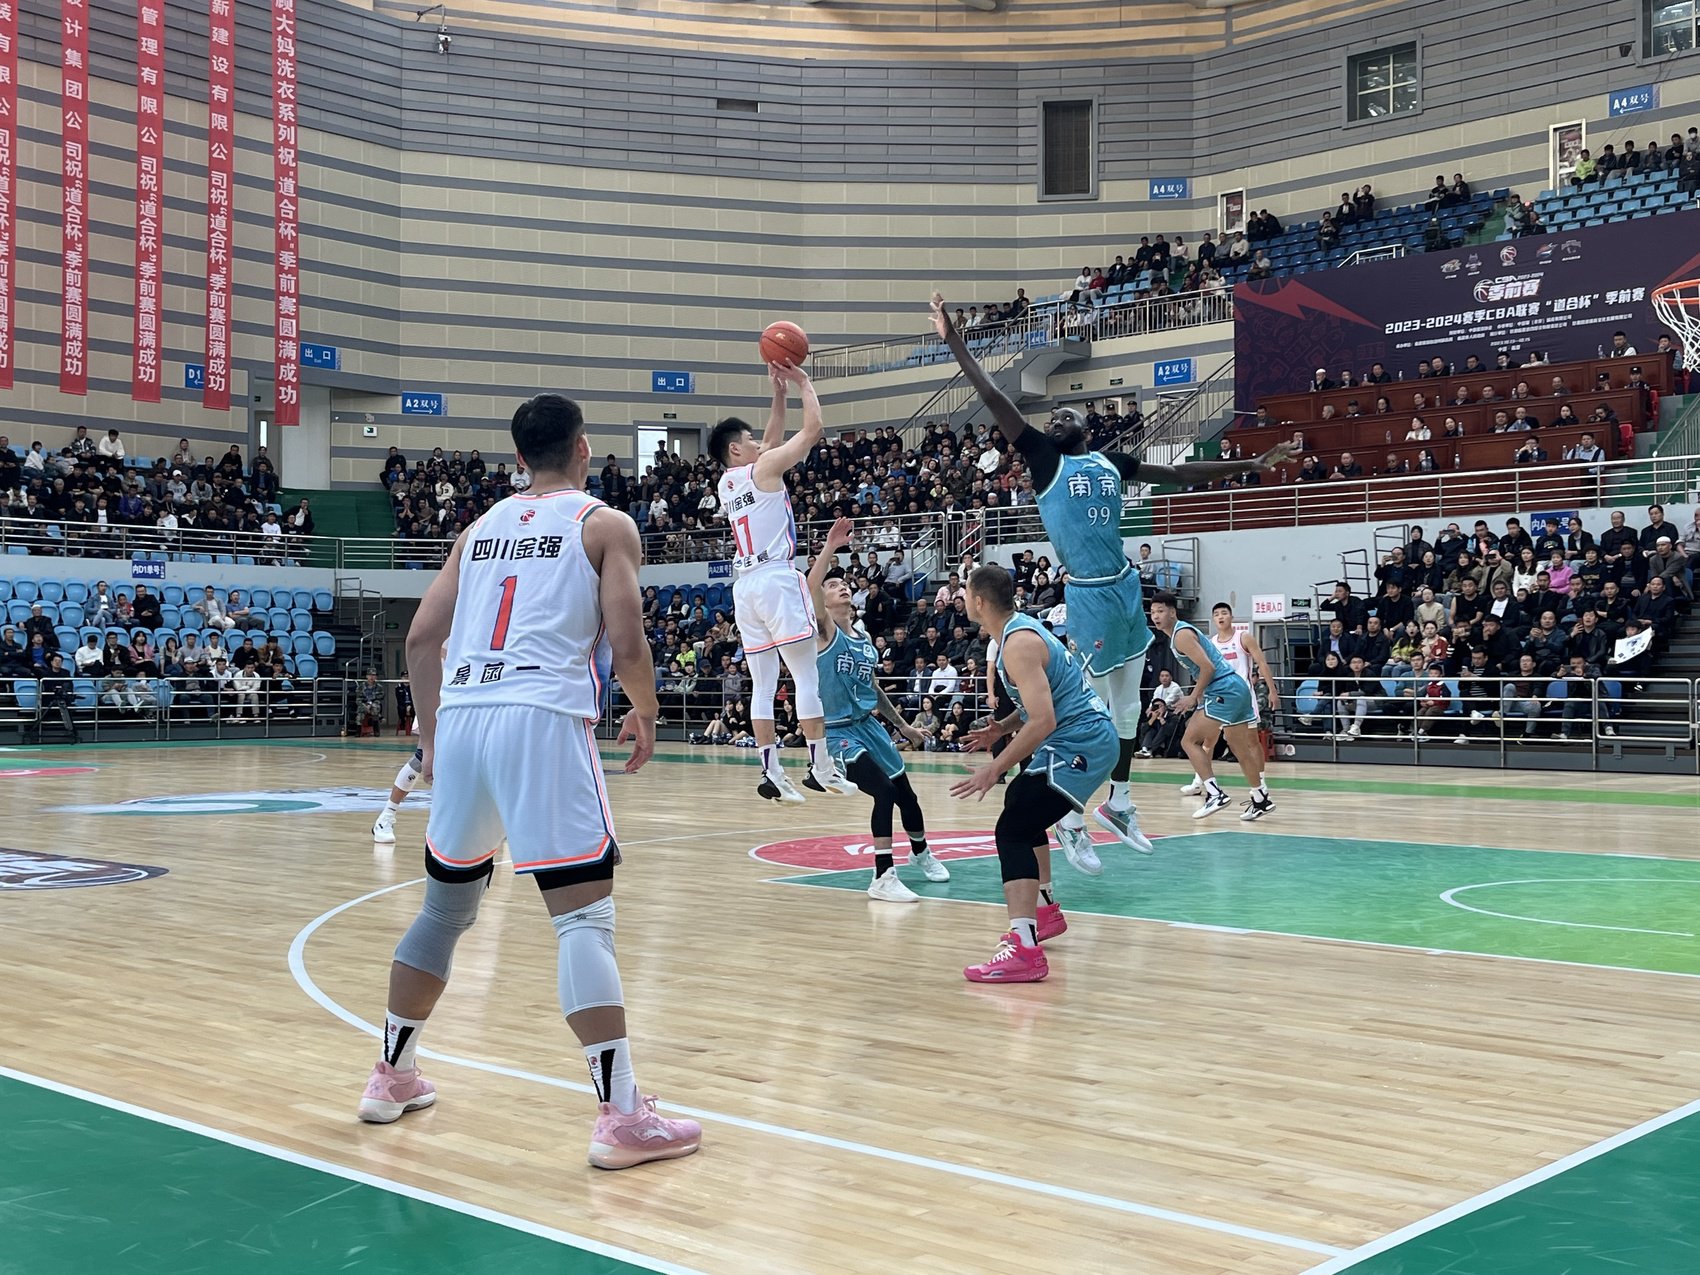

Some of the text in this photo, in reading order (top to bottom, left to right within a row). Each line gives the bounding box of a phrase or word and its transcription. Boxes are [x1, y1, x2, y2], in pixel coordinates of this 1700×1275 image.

[1488, 279, 1541, 301] 季前赛
[1605, 287, 1645, 305] 季前赛
[304, 347, 331, 361] 出口
[657, 376, 685, 387] 出口
[1067, 473, 1118, 498] 南京
[1087, 506, 1111, 527] 99
[731, 514, 755, 558] 17
[471, 535, 563, 562] 四川金强
[489, 575, 518, 651] 1
[836, 652, 874, 681] 南京
